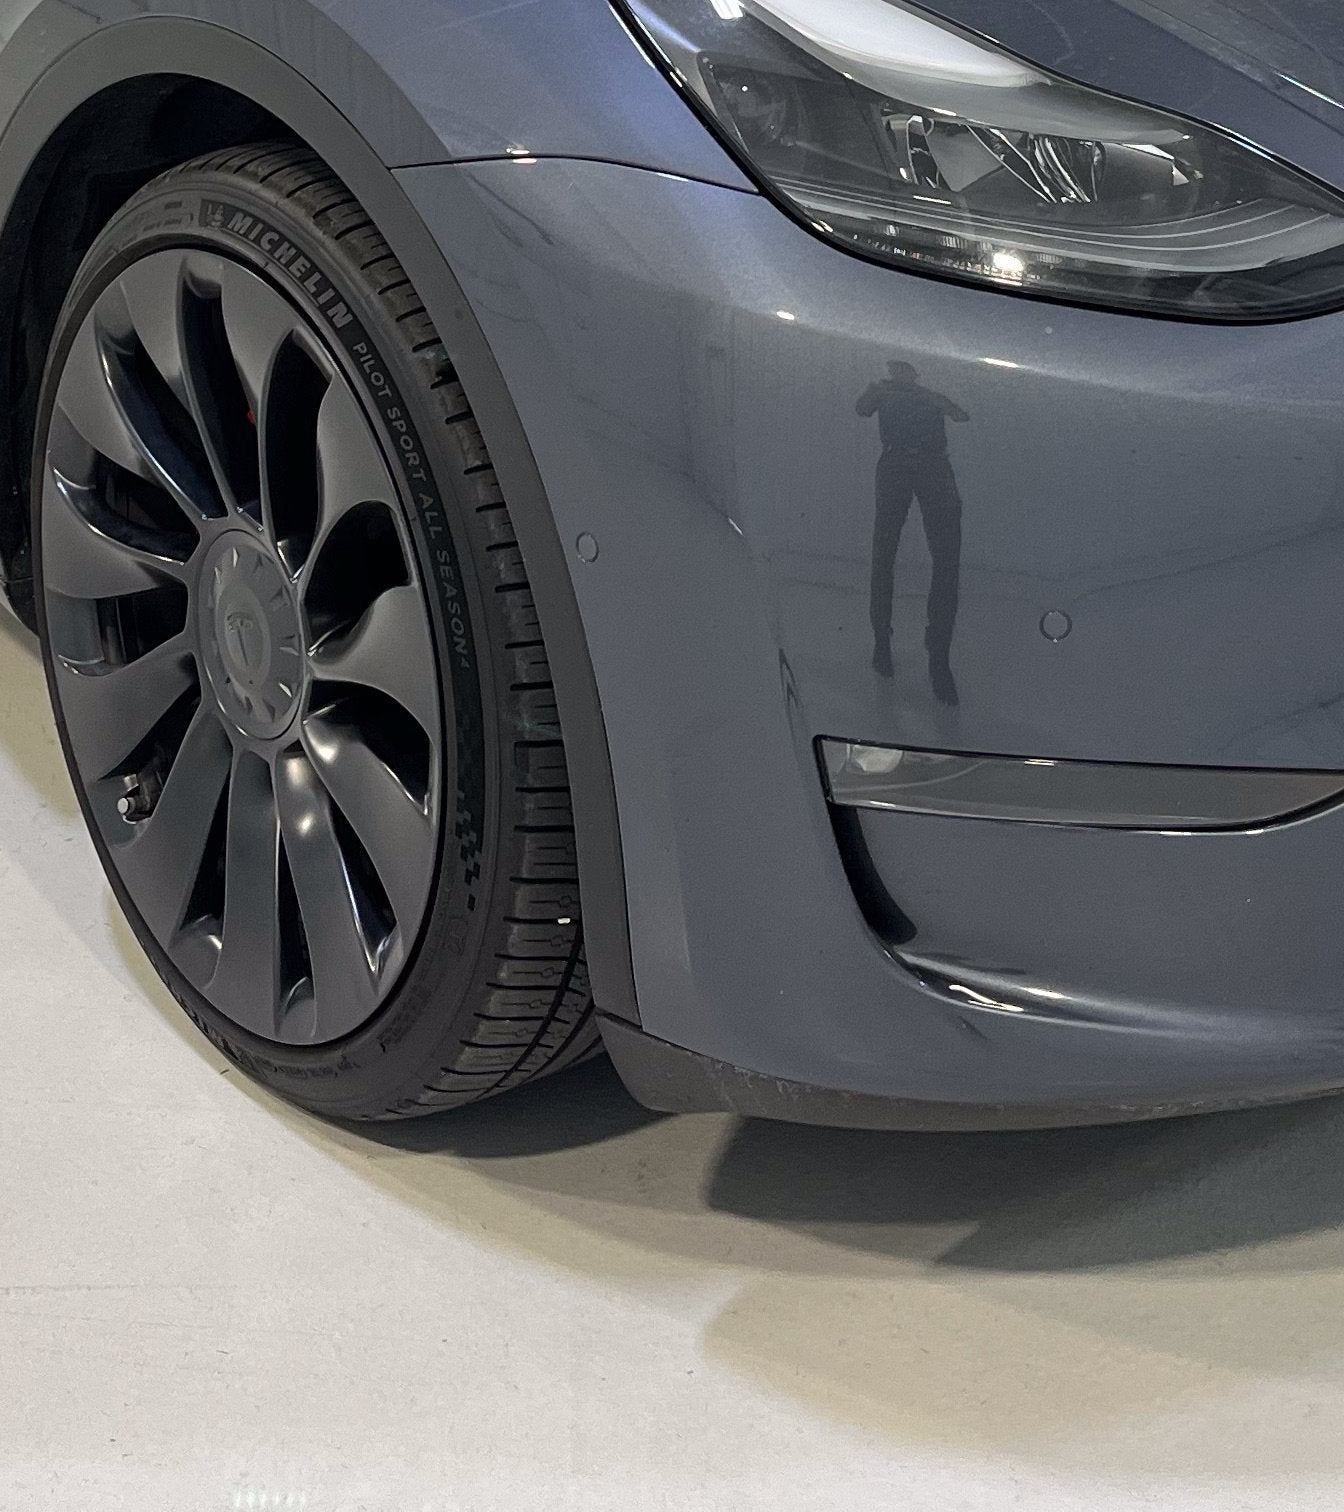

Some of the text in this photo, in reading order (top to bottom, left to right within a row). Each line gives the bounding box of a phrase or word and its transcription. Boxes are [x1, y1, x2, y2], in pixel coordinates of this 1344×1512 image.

[227, 212, 354, 329] MICHELIN
[352, 342, 392, 399] PILOT
[387, 407, 427, 483] SPORT
[419, 492, 443, 540] ALL
